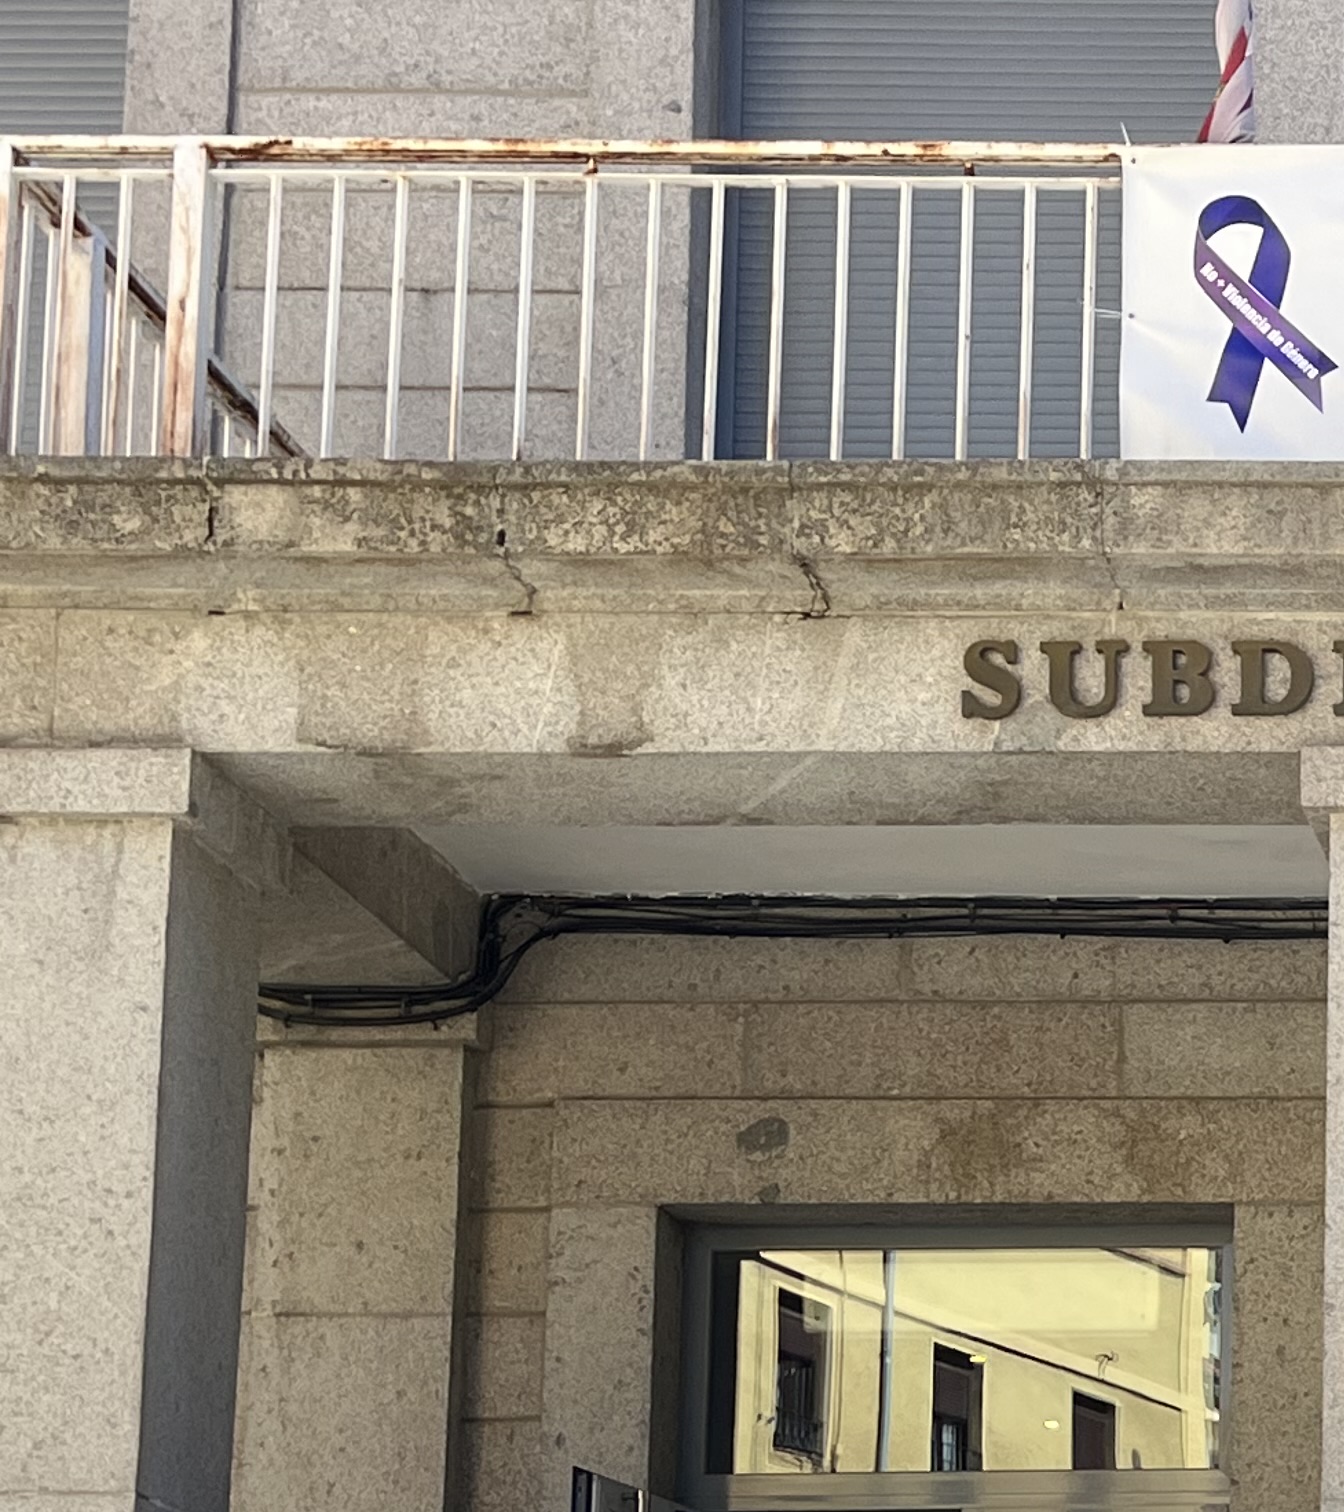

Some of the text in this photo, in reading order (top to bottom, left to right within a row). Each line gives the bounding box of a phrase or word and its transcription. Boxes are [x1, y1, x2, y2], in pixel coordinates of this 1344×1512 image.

[1200, 262, 1219, 282] No
[1222, 283, 1271, 335] Violencia
[1266, 329, 1285, 347] de
